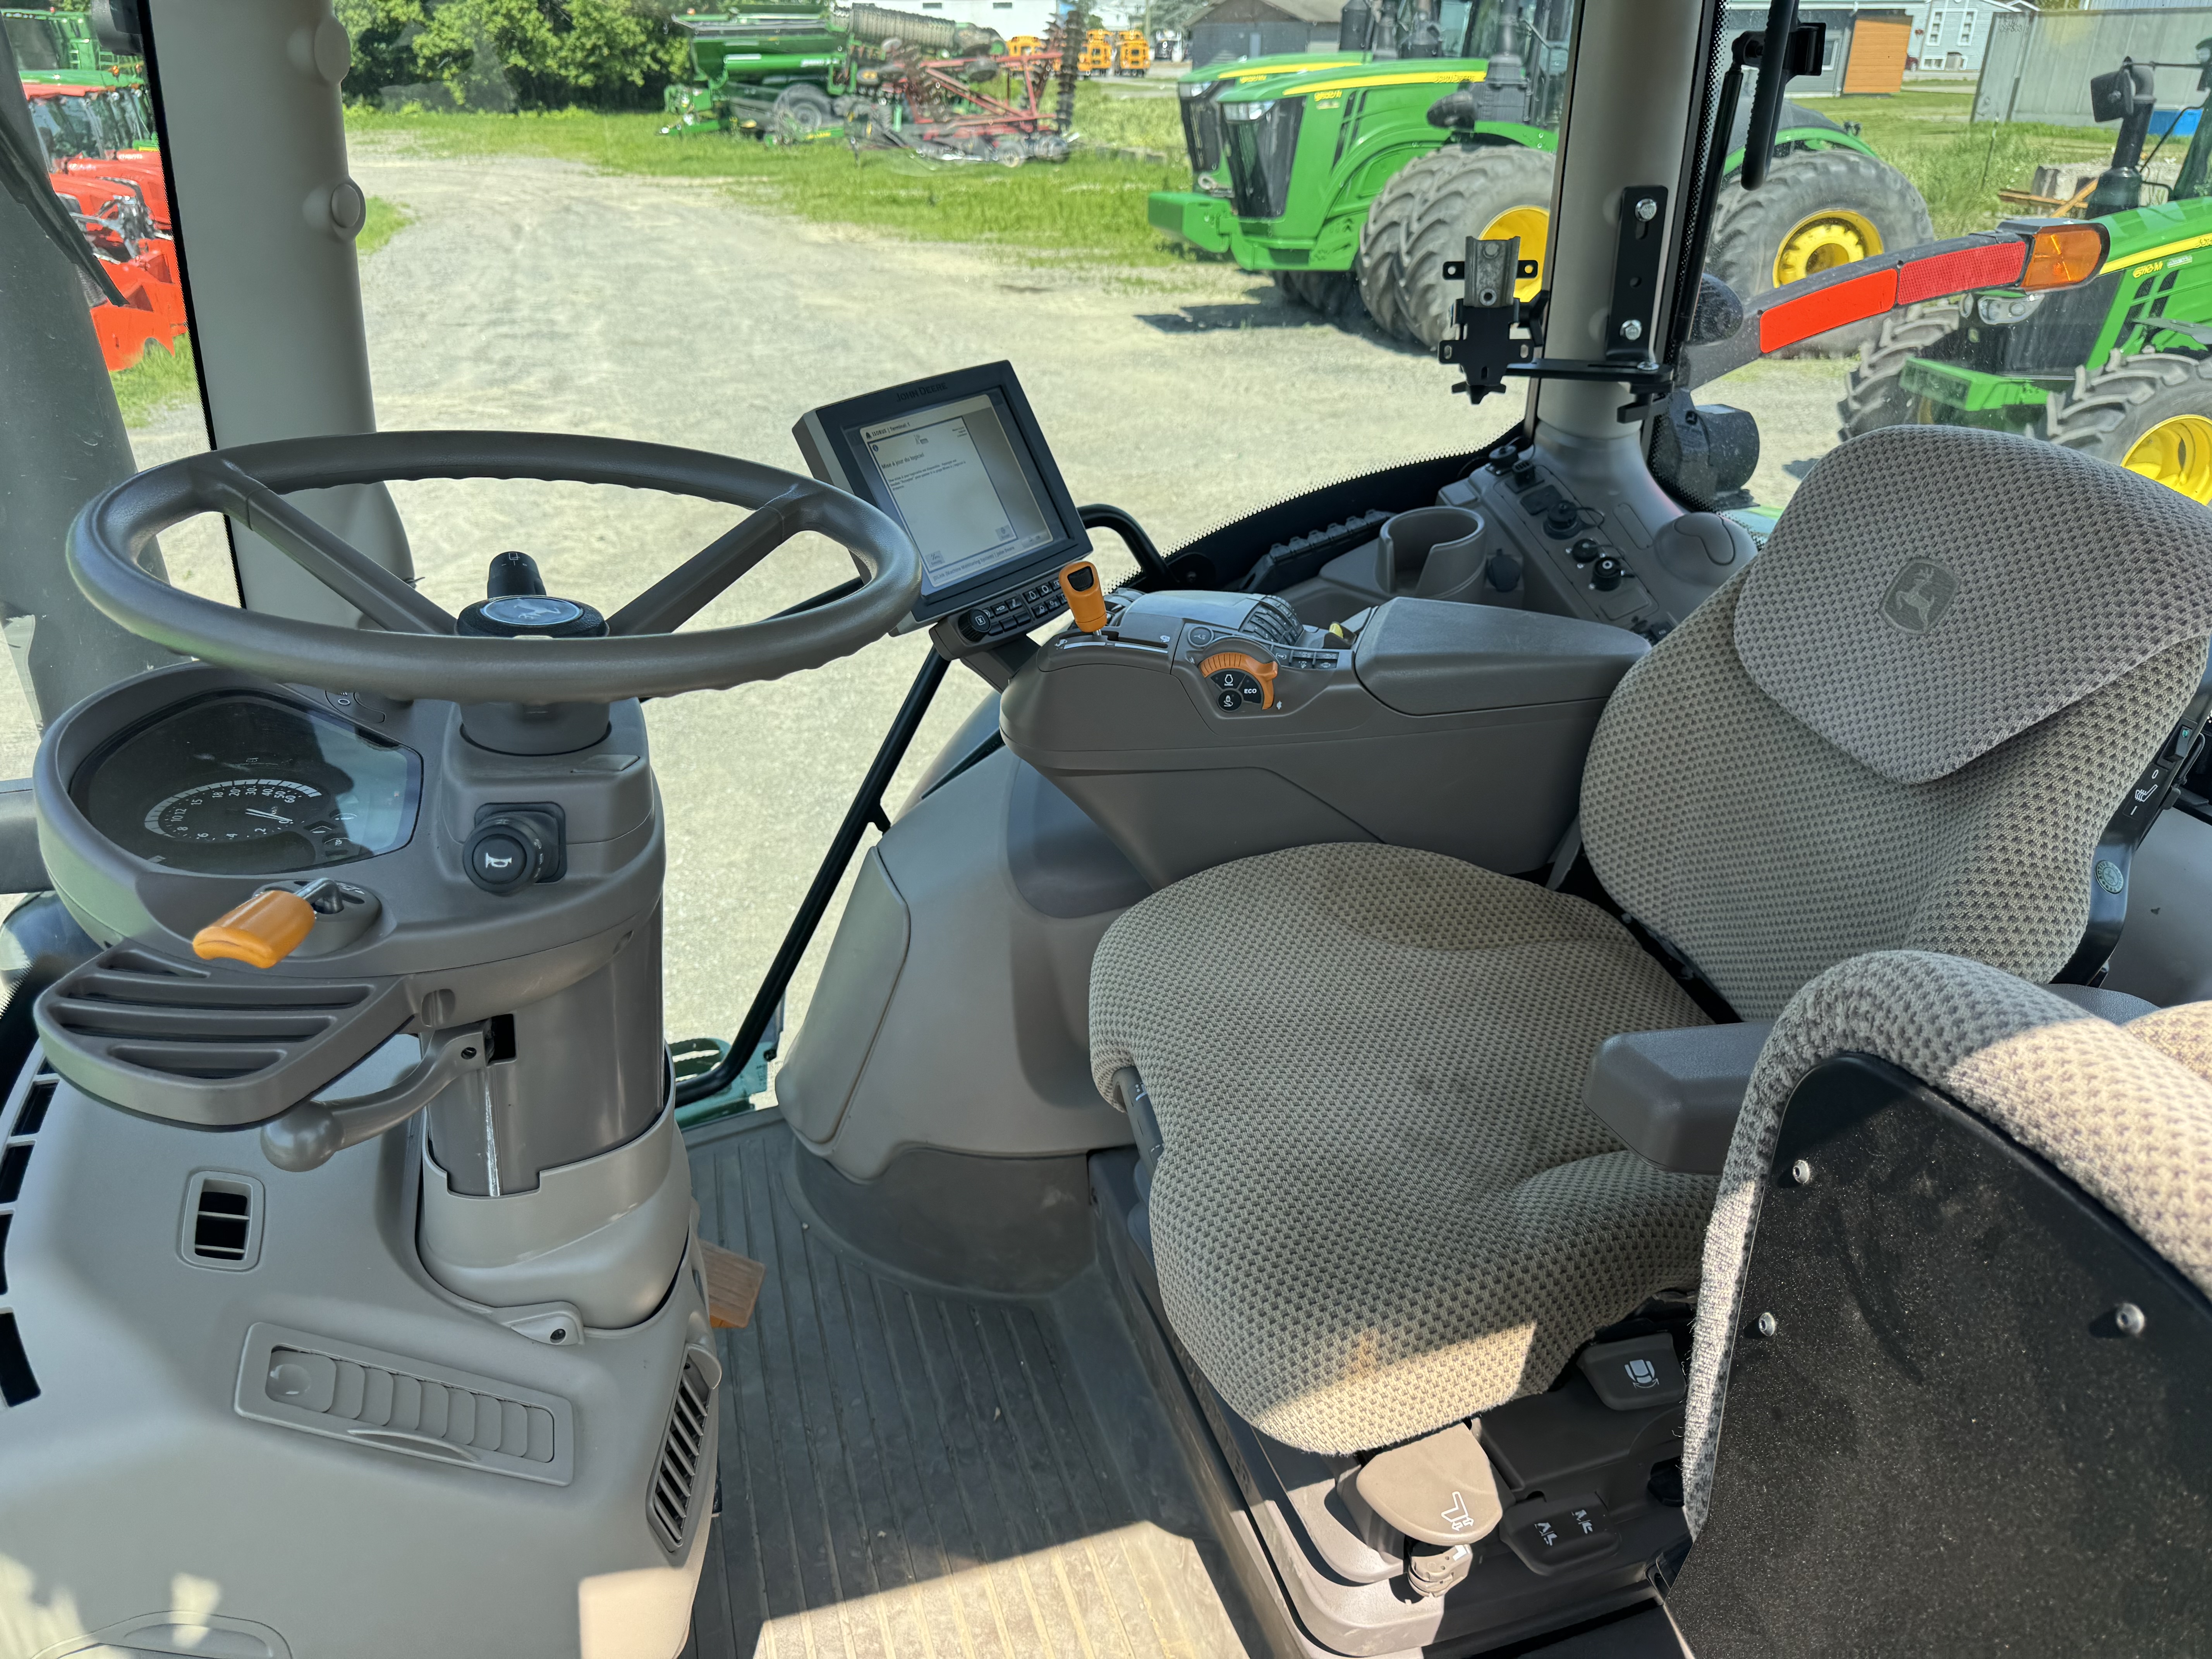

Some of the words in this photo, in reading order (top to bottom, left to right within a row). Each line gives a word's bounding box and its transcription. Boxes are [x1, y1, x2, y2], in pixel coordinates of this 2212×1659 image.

[896, 390, 919, 402] JOHN
[919, 382, 948, 395] DEERE
[284, 795, 296, 803] 60
